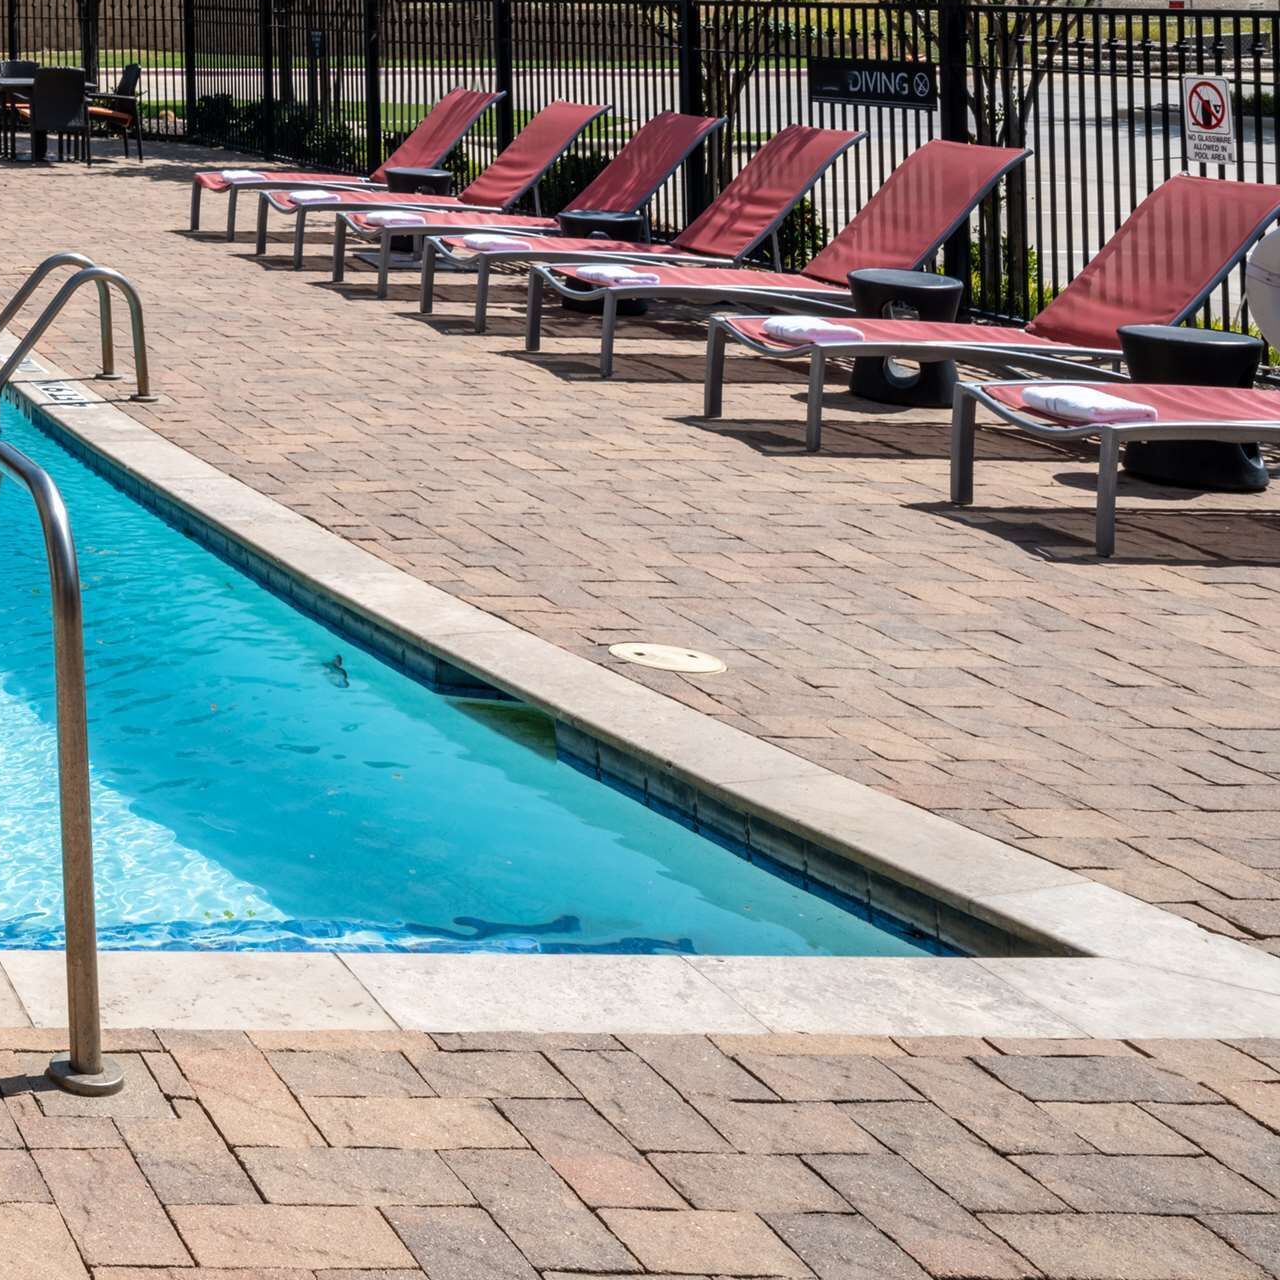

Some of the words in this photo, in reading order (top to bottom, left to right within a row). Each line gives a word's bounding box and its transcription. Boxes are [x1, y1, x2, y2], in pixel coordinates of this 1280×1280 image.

[848, 71, 909, 95] DIVING
[1198, 135, 1232, 144] GLASSWARE
[1194, 144, 1219, 152] ALLOWED
[1195, 152, 1209, 160] POOL
[1211, 153, 1226, 161] AREA
